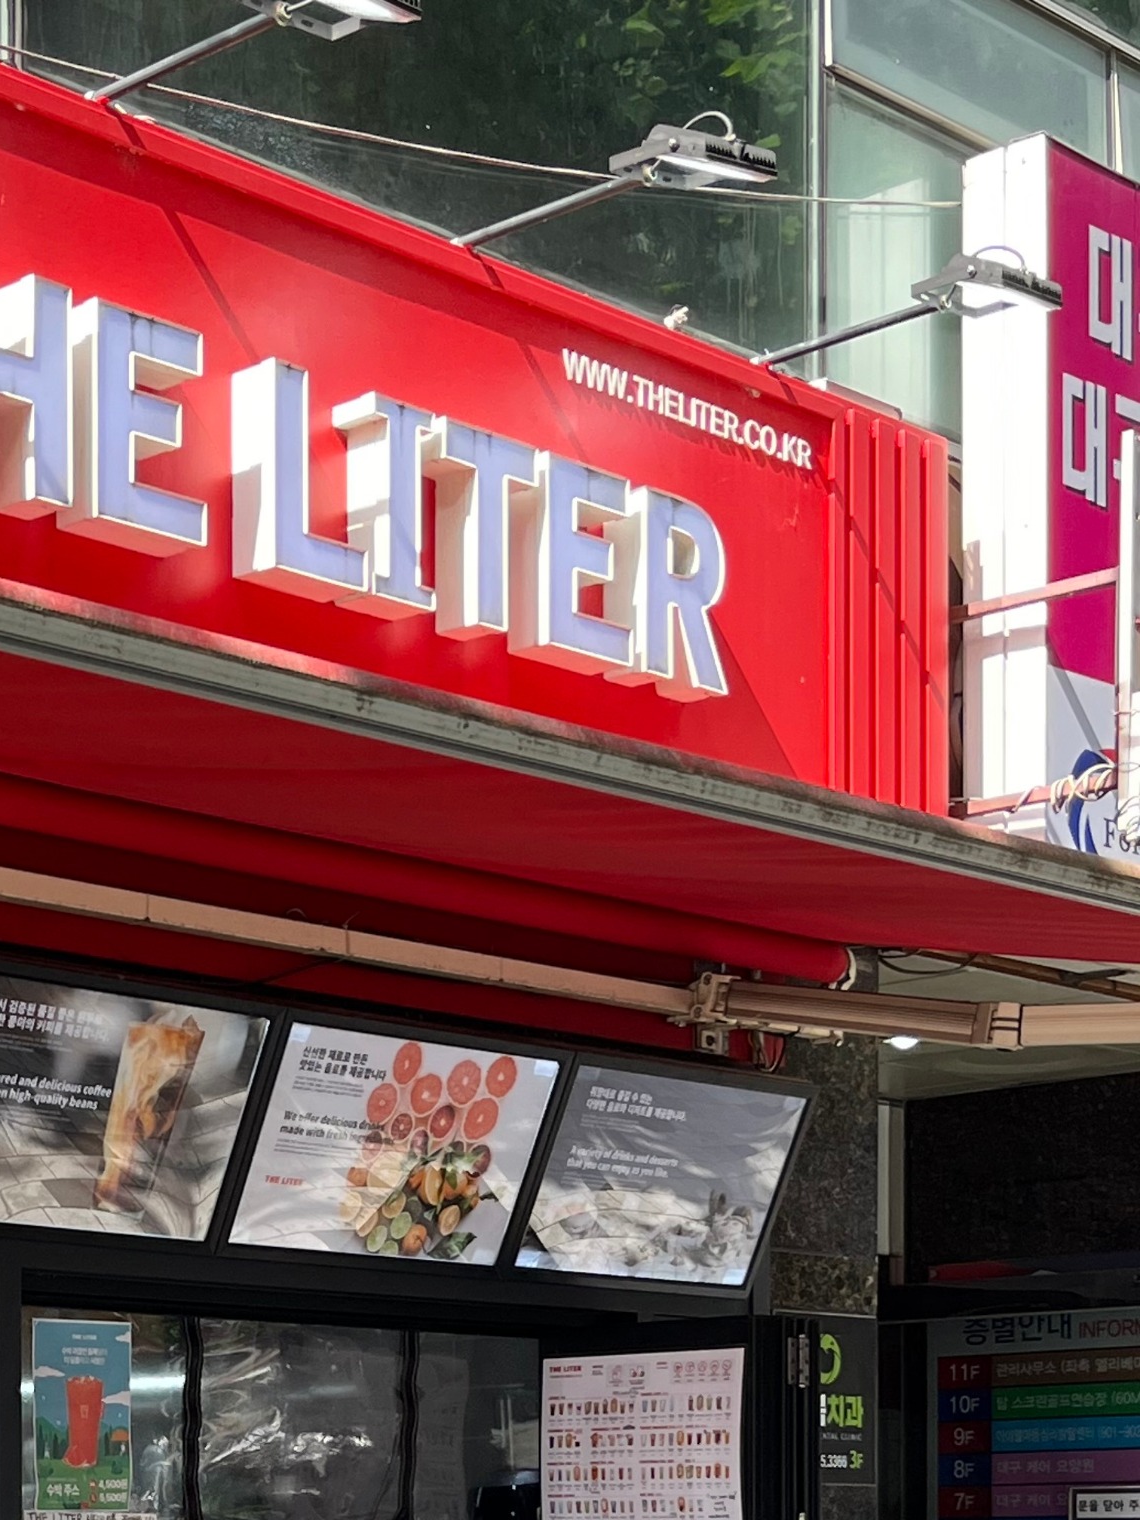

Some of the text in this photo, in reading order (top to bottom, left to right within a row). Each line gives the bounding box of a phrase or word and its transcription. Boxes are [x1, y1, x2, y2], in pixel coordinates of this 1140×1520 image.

[562, 347, 813, 471] WWW.THELITER.CO.KR
[231, 357, 729, 702] LITER
[18, 1075, 37, 1087] and
[38, 1077, 82, 1094] delicious
[83, 1084, 112, 1098] coffee
[9, 1089, 69, 1109] high-quality
[69, 1097, 99, 1111] beans
[949, 1363, 981, 1382] 11F
[949, 1395, 981, 1414] 10F
[953, 1427, 975, 1446] 9F
[953, 1460, 975, 1479] 8F
[953, 1493, 975, 1511] 7F
